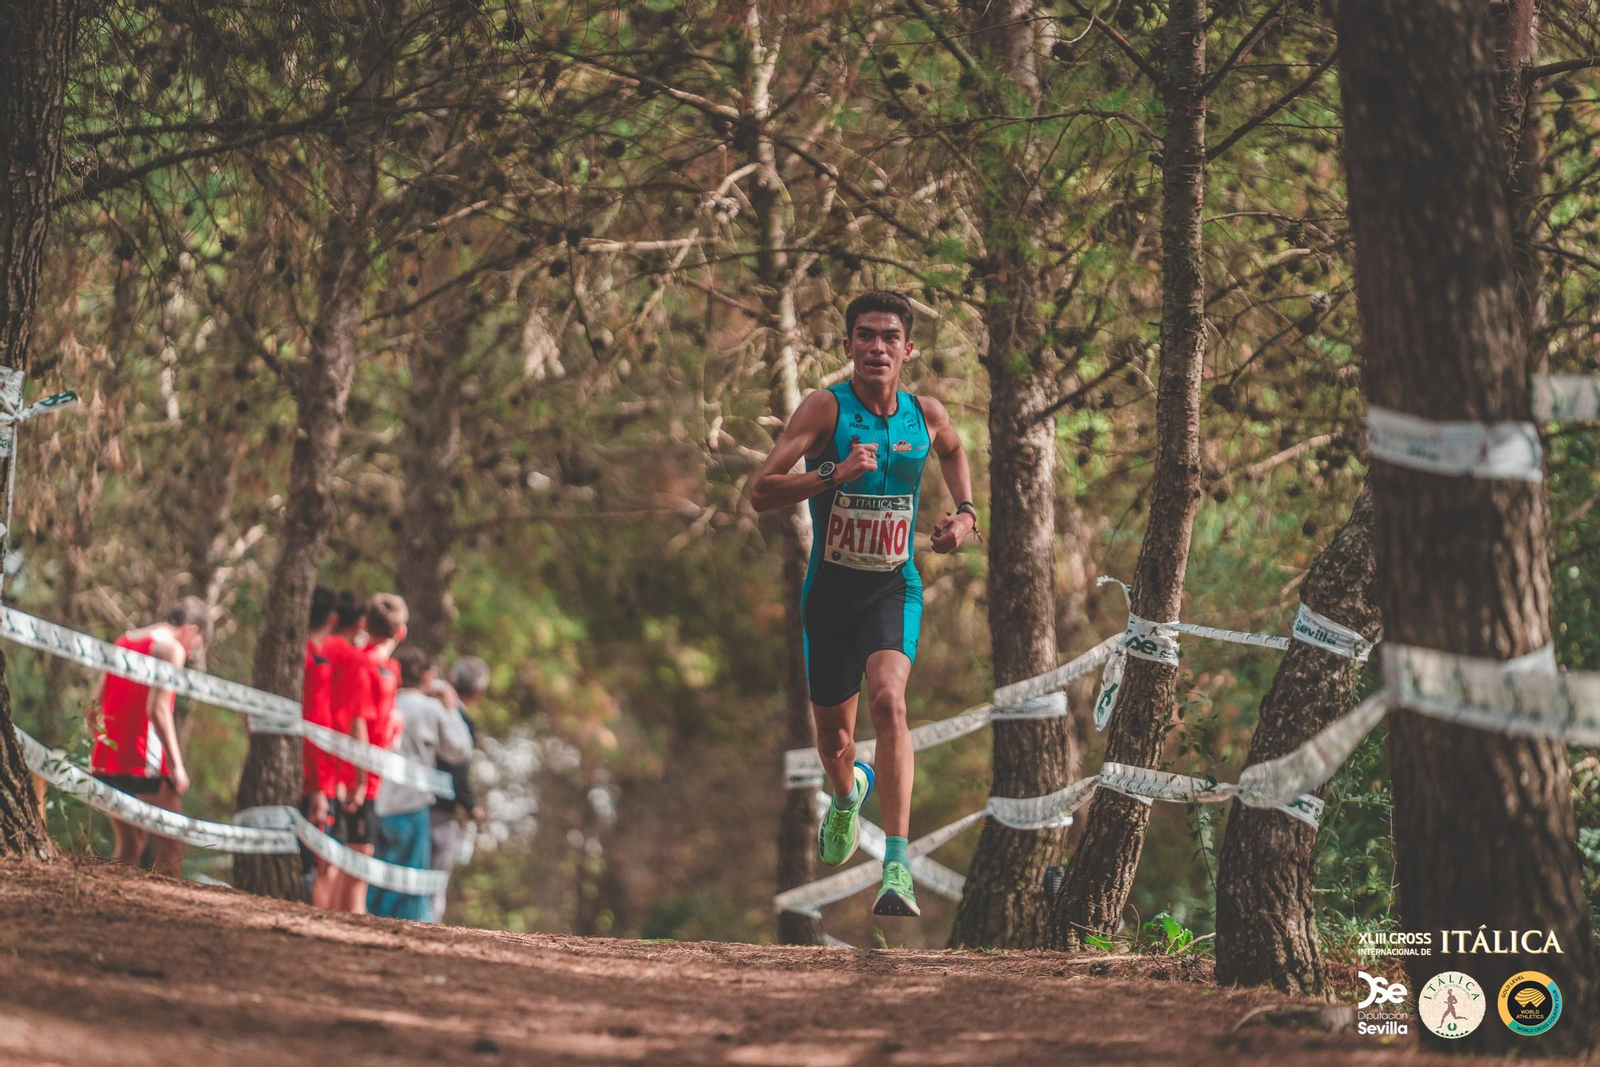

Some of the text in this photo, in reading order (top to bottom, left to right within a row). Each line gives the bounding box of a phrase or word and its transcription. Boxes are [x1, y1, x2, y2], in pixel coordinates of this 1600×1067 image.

[849, 422, 870, 431] VIATOR
[855, 497, 893, 508] ITÁLICA
[828, 512, 906, 555] PATIÑO
[1295, 620, 1337, 645] Sevilla
